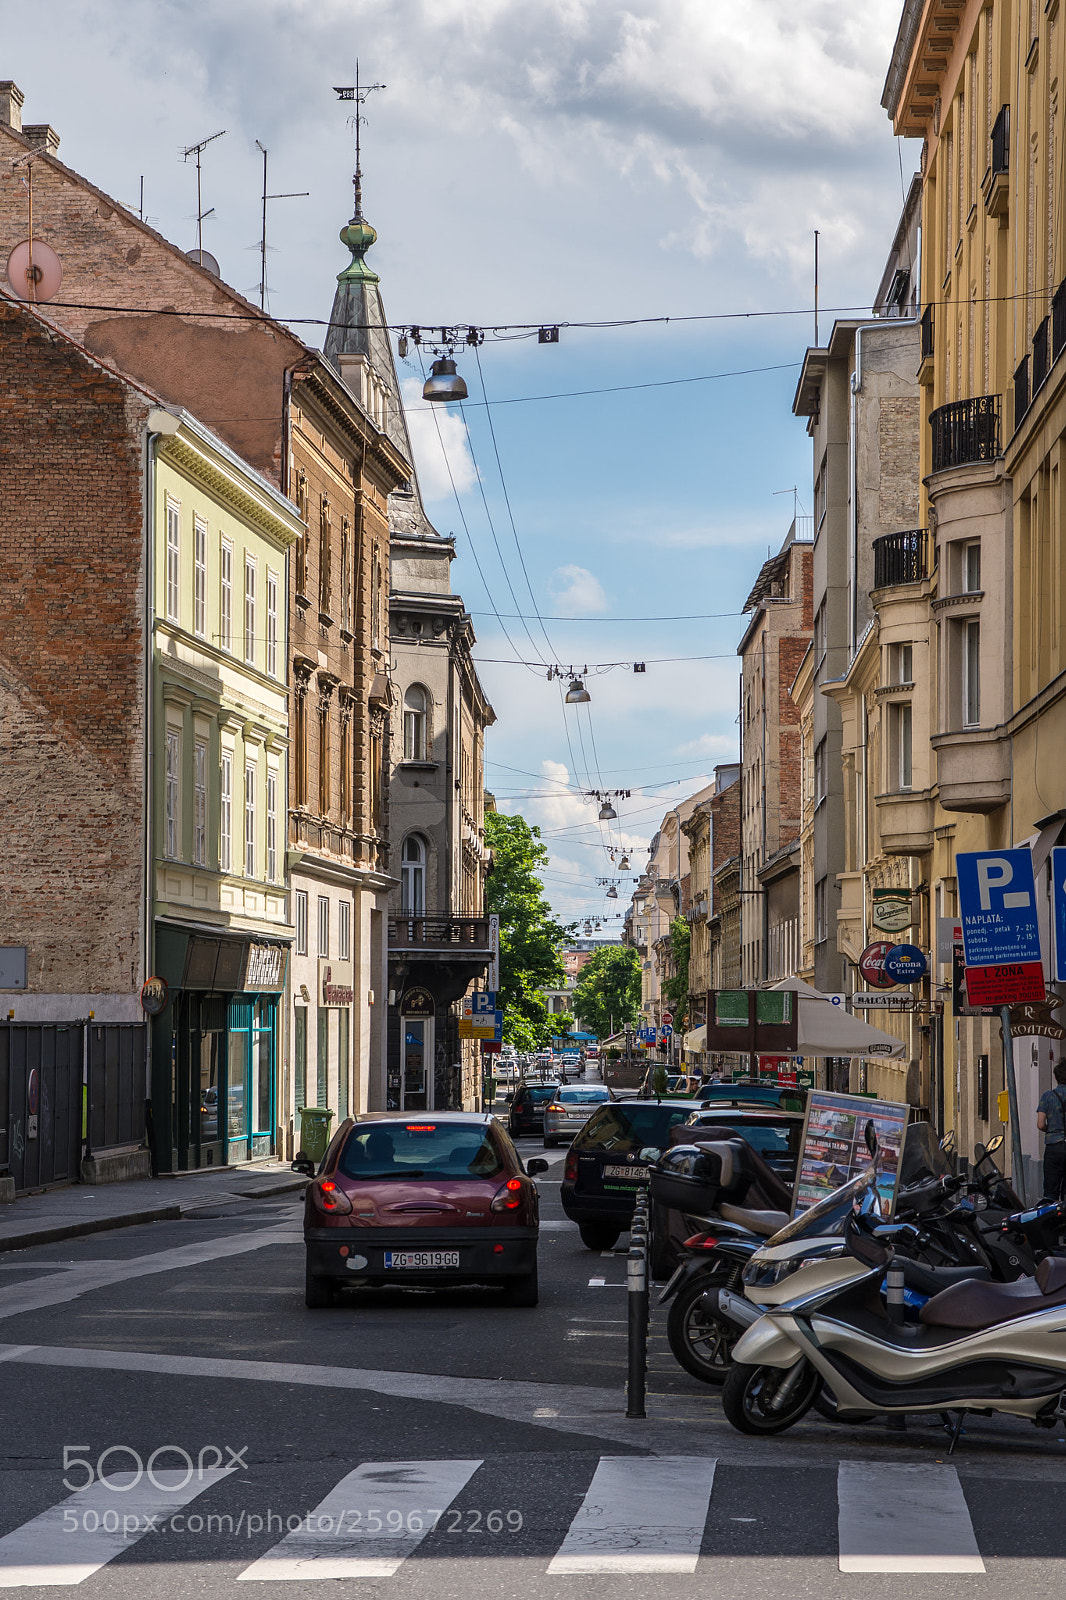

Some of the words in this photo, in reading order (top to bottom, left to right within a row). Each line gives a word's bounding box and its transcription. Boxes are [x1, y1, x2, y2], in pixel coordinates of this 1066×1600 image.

[976, 857, 1014, 911] P
[965, 914, 1003, 925] NAPLATA:
[966, 928, 988, 936] ponedj.
[995, 925, 1011, 933] petak
[889, 961, 921, 969] Corona
[983, 969, 990, 978] 1.
[994, 966, 1024, 977] ZONA
[477, 994, 489, 1010] P
[1002, 1025, 1063, 1039] ROATICA
[610, 1166, 620, 1176] ZG
[393, 1253, 407, 1266] ZG
